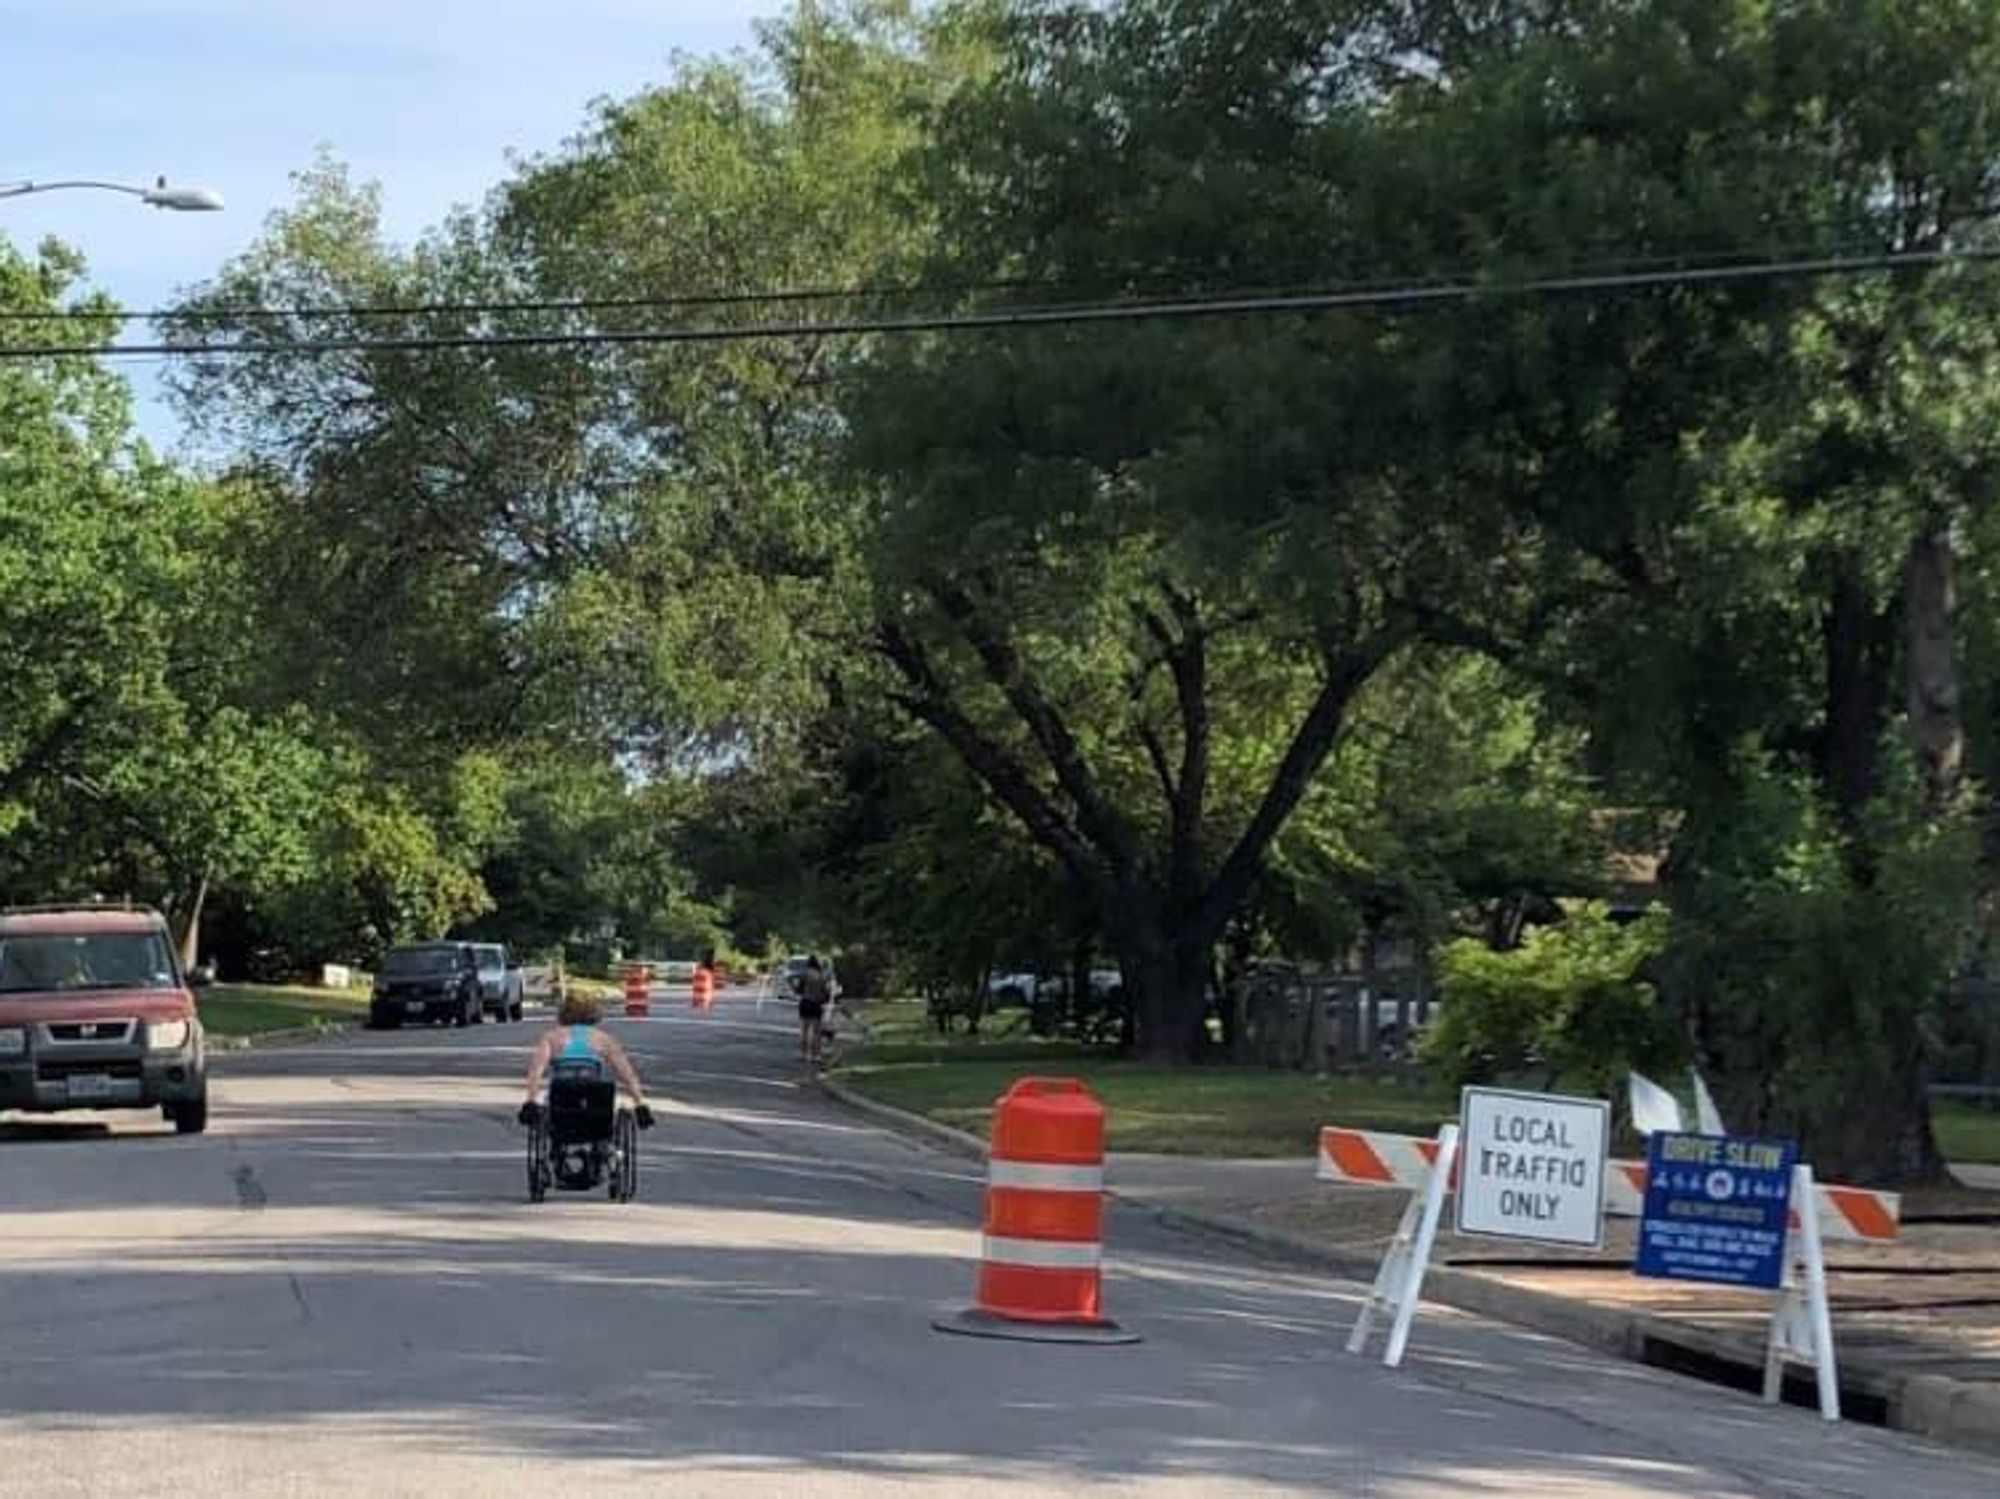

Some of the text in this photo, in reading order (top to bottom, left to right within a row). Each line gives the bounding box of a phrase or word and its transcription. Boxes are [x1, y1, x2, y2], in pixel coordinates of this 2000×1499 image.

[1494, 1115, 1575, 1149] LOCAL
[1662, 1136, 1783, 1172] DRIVE SLOW
[1501, 1190, 1561, 1220] ONLY
